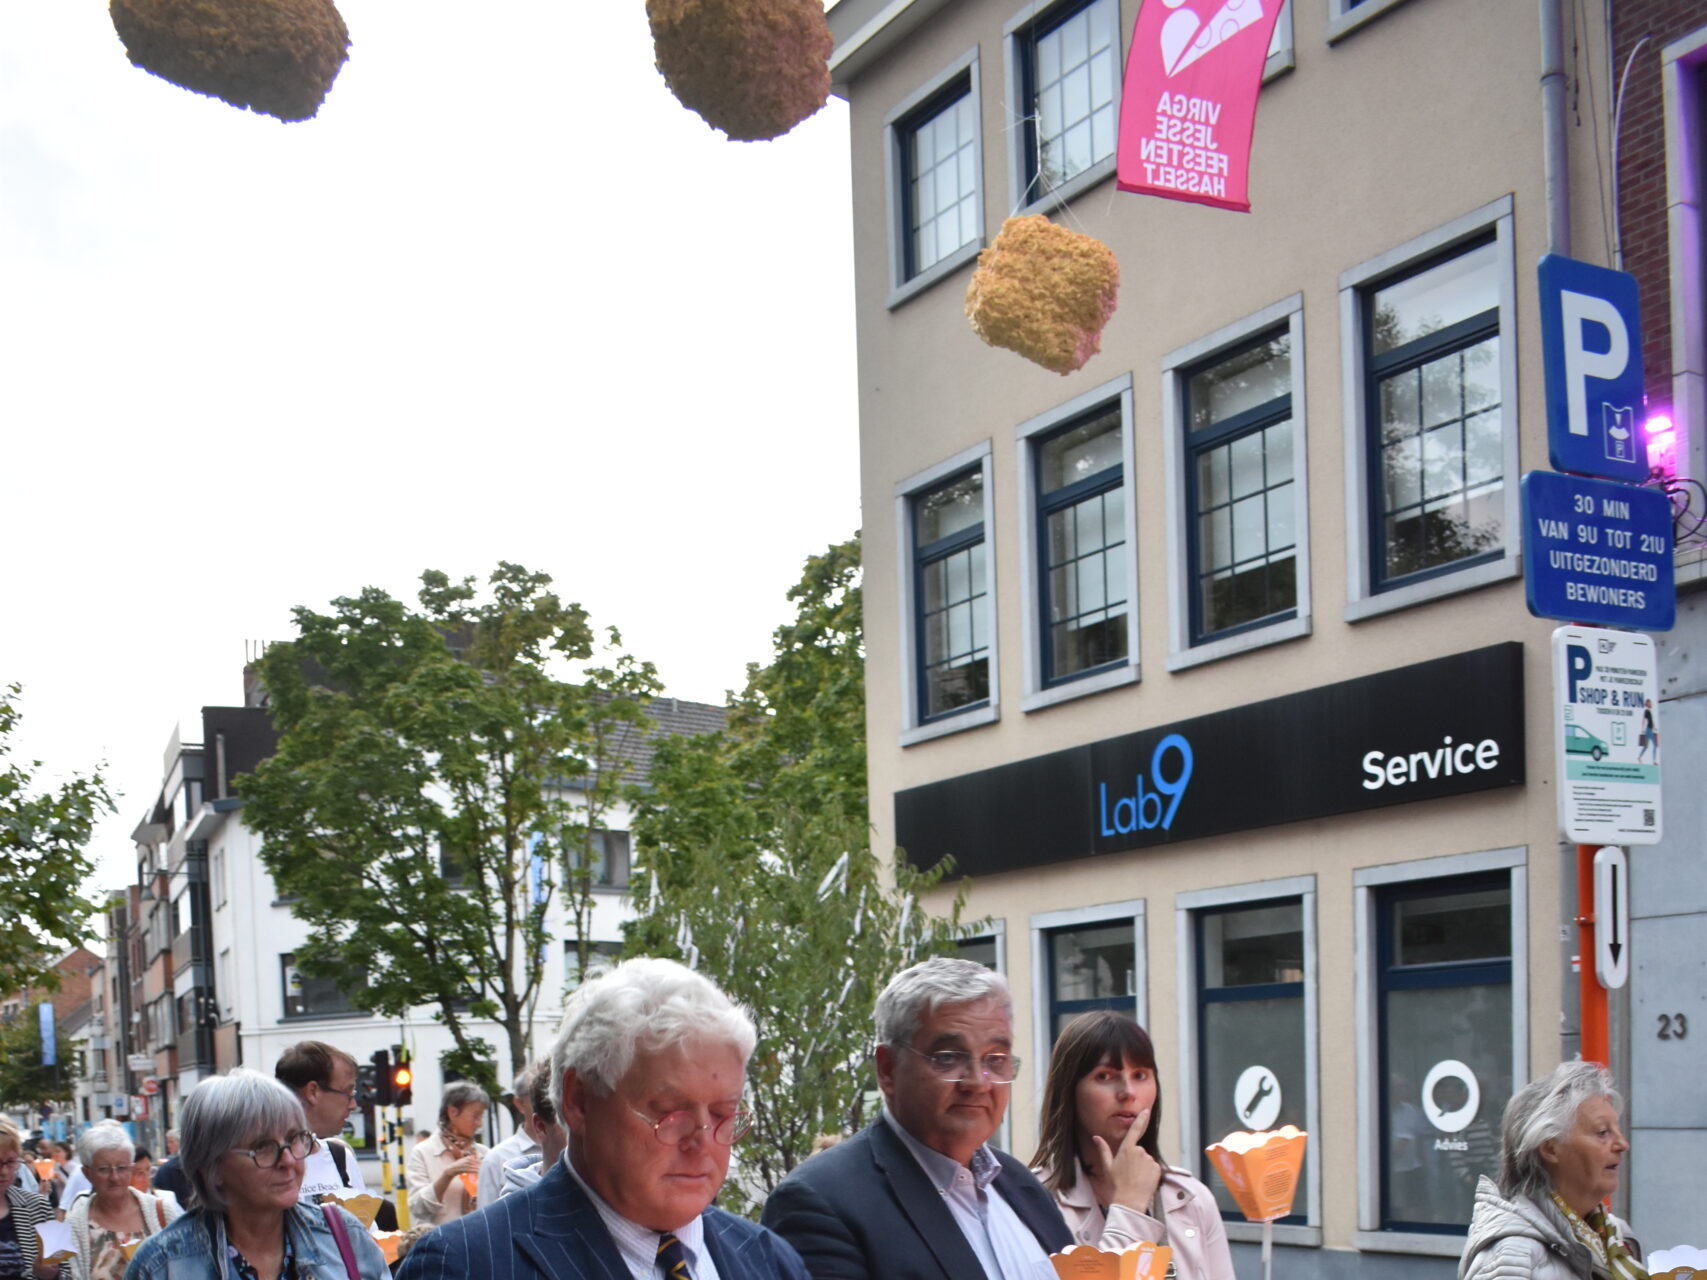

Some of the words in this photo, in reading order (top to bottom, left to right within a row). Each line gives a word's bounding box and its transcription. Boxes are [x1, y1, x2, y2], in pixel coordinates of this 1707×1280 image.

[1560, 289, 1630, 437] P
[1574, 494, 1595, 515] 30
[1603, 499, 1630, 520] MIN
[1538, 518, 1569, 540] VAN
[1577, 524, 1598, 545] 9U
[1605, 528, 1633, 550] TOT
[1640, 534, 1665, 554] 21U
[1549, 549, 1657, 582] UITGEZONDERD
[1566, 582, 1646, 609] BEWONERS
[1566, 644, 1592, 704] P
[1579, 687, 1607, 705] SHOP
[1611, 690, 1619, 706] &
[1623, 691, 1645, 708] RUN
[1362, 736, 1499, 790] Service
[1100, 734, 1193, 837] Lab9
[1657, 1013, 1687, 1041] 23
